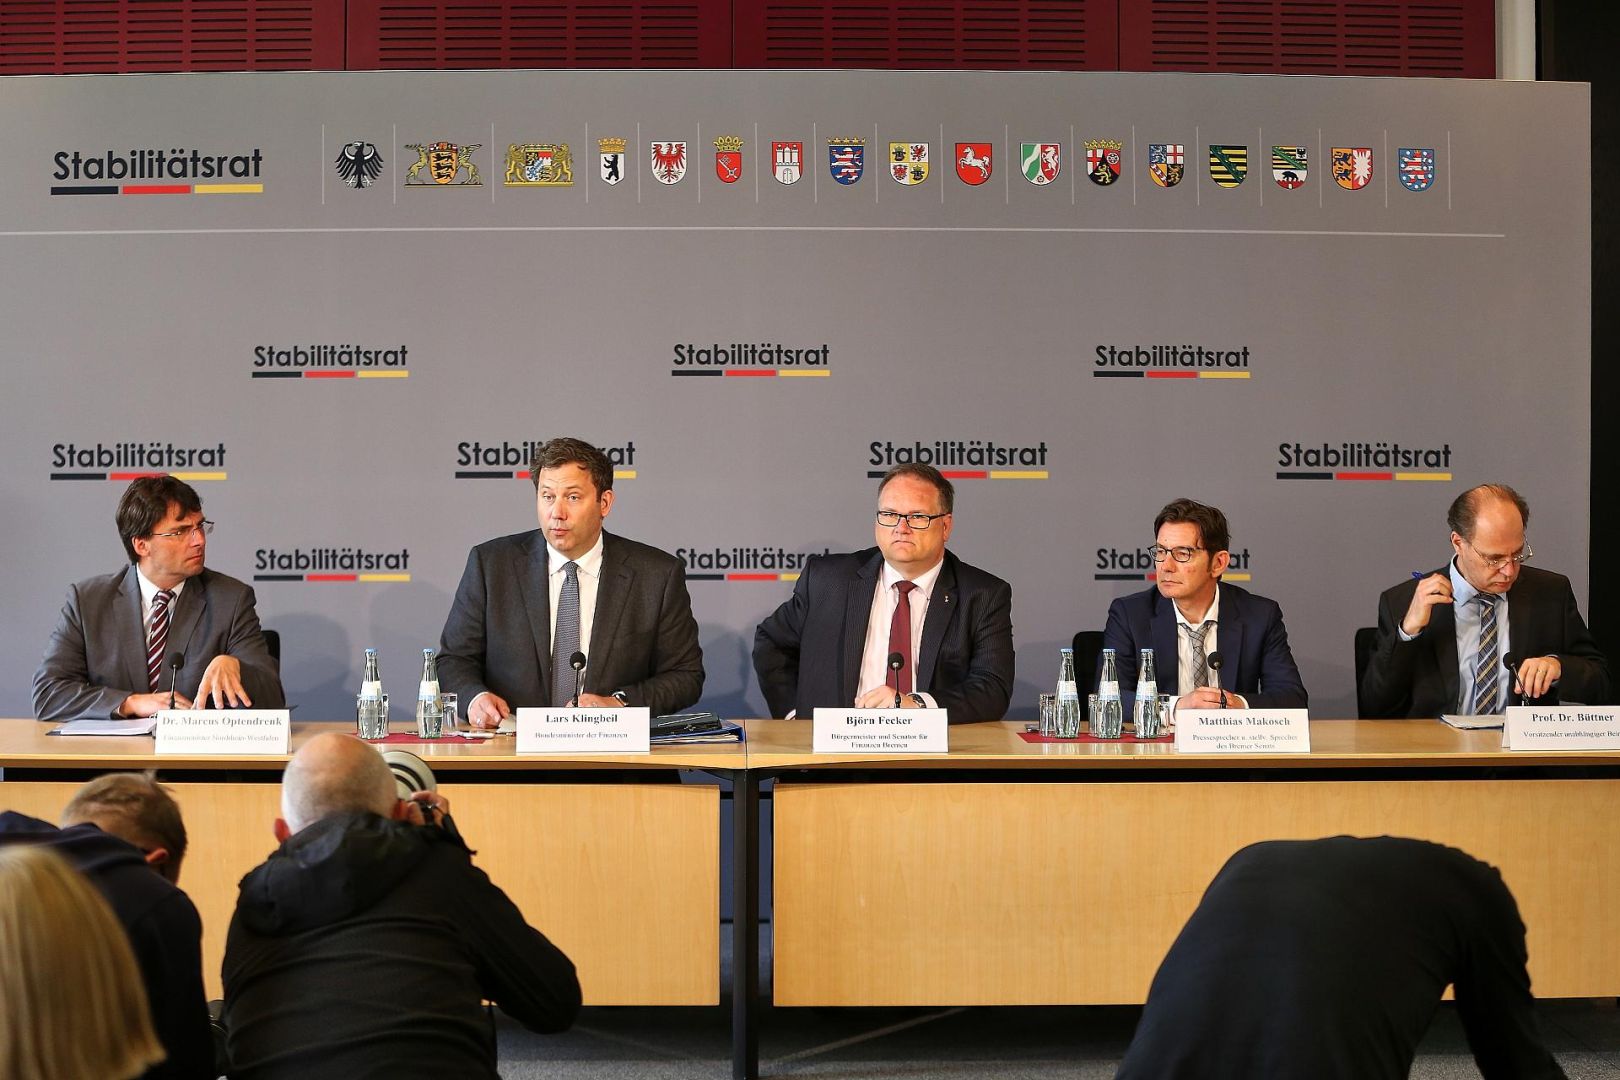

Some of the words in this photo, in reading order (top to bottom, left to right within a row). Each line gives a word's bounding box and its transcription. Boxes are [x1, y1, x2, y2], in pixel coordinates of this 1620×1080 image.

[52, 148, 263, 180] Stabilitätsrat
[253, 344, 409, 367] Stabilitätsrat
[673, 343, 830, 366] Stabilitätsrat
[1095, 345, 1250, 368] Stabilitätsrat
[52, 442, 226, 468] Stabilitätsrat
[456, 441, 636, 466] Stabilat
[869, 440, 1048, 466] Stabilitätsrat
[1278, 442, 1452, 468] Stabilitätsrat
[255, 547, 410, 570] Stabilitätsrat
[675, 547, 830, 570] Stabilitätsr
[162, 717, 178, 726] Dr.
[181, 717, 219, 726] Marcus
[222, 717, 282, 727] Optendrenk
[546, 714, 569, 723] Lars
[572, 714, 618, 725] Klingbeil
[846, 716, 875, 727] Björn
[878, 716, 913, 725] Fecker
[1198, 717, 1243, 726] Matthias
[1246, 717, 1291, 726] Makosch
[1532, 713, 1556, 722] Prof.
[1559, 713, 1574, 722] Dr.
[1577, 713, 1615, 722] Büttner
[586, 731, 597, 739] der
[831, 733, 876, 741] Bürgermeister
[1192, 734, 1240, 743] Pressesprecher
[1269, 734, 1298, 743] Sprecher
